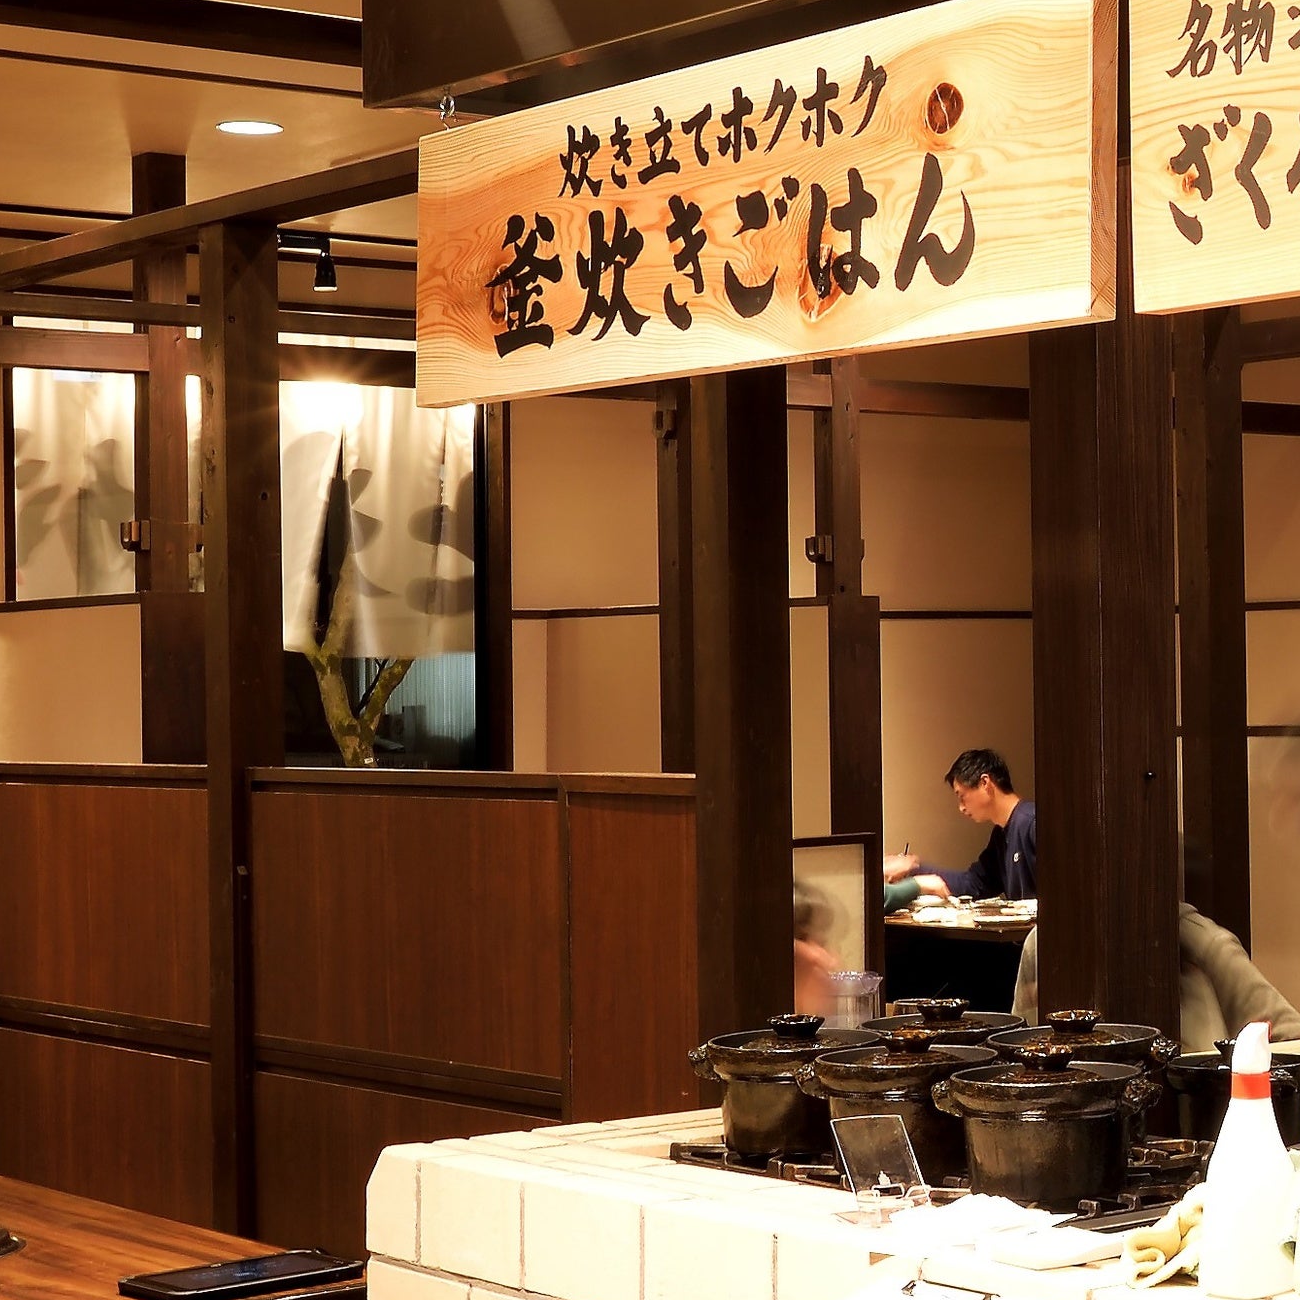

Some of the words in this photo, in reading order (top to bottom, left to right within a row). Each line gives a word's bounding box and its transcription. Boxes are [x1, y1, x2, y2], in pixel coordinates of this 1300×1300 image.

[558, 55, 888, 199] 炊き立てホクホク
[484, 152, 976, 360] 釜炊きごはん
